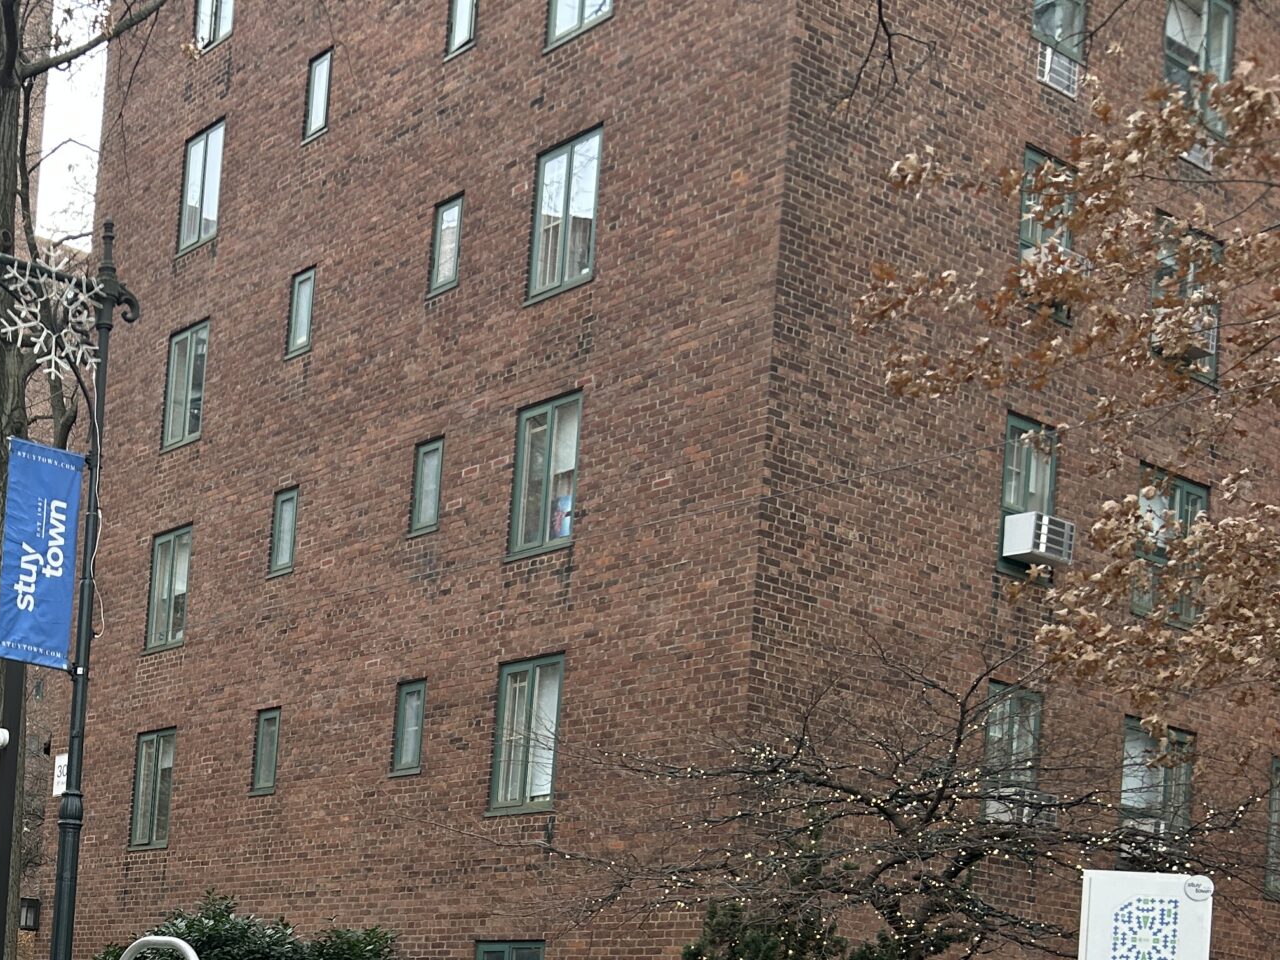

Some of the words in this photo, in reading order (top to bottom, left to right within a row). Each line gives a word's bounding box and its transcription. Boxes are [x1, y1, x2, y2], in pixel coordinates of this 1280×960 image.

[17, 451, 76, 471] STUYTOWN.COM
[42, 500, 67, 578] town
[14, 541, 44, 612] stuy
[1, 641, 61, 658] STUYTOWN.COM
